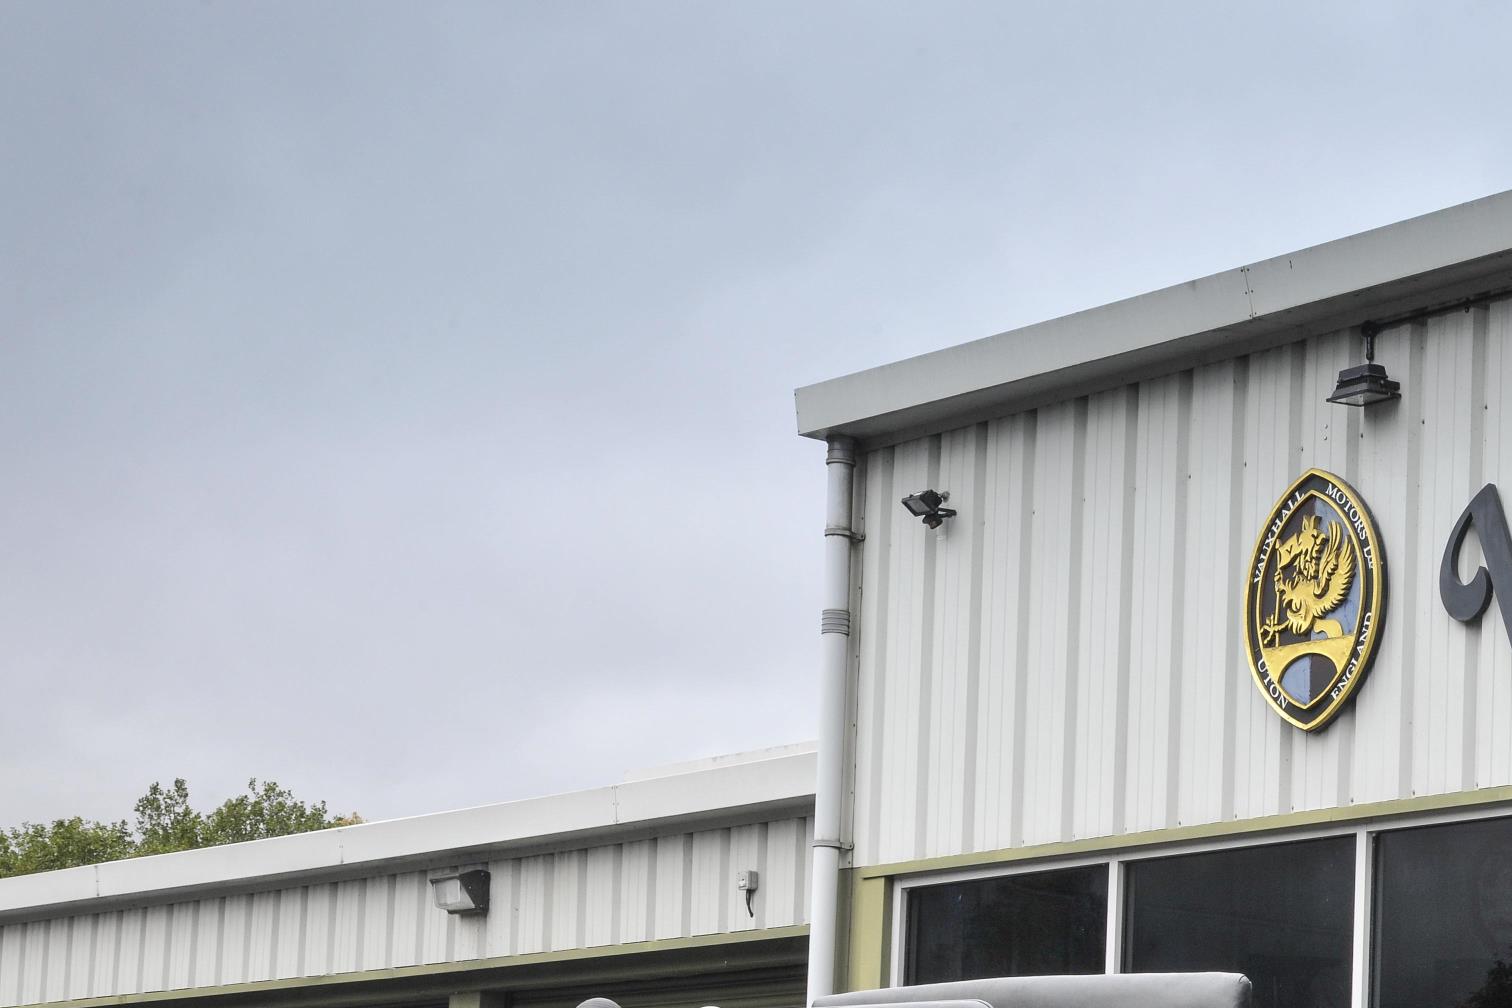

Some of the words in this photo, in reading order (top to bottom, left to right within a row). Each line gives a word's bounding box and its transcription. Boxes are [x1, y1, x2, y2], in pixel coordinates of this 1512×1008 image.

[1253, 490, 1305, 583] VAUXHALL
[1325, 483, 1367, 540] MOTORS
[1330, 612, 1372, 700] ENGLAND
